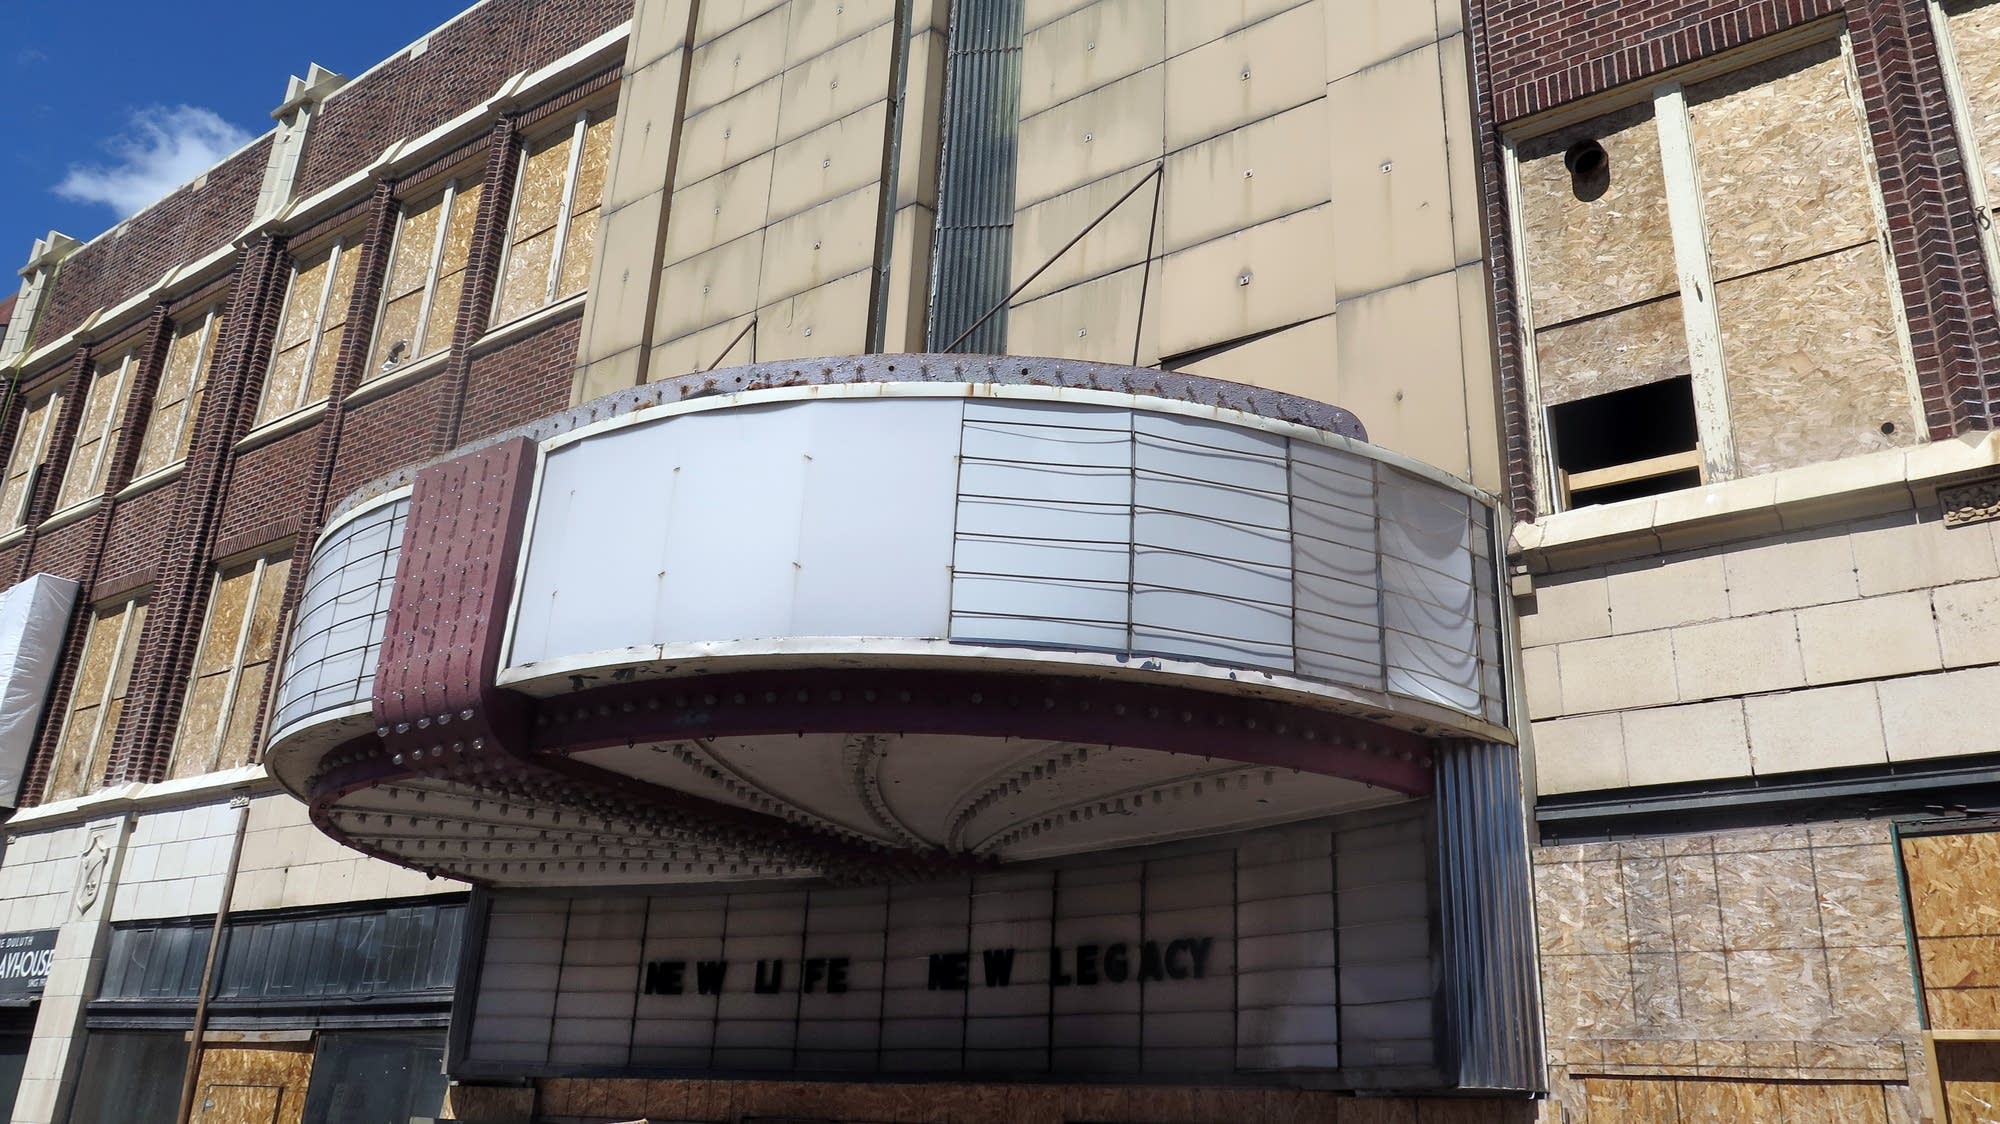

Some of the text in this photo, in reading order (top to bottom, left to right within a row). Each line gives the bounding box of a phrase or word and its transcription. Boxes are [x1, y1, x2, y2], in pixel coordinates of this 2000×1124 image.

[6, 936, 34, 948] DULUTH
[0, 949, 56, 979] AYHOUSE
[645, 937, 1213, 995] NEW LIFE NEW LEGACY
